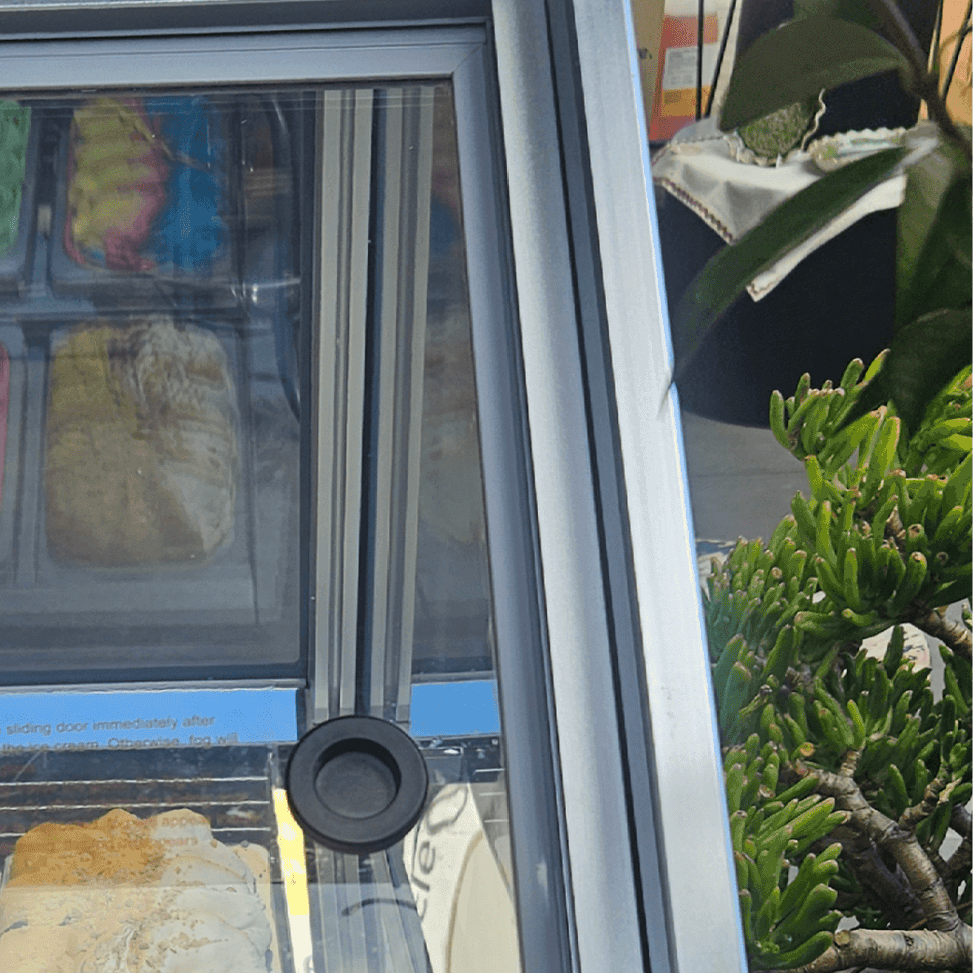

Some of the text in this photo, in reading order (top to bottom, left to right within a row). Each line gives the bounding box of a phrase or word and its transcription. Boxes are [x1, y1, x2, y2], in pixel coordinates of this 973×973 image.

[6, 722, 52, 736] sliding
[55, 722, 88, 733] door
[93, 716, 178, 731] immediately
[182, 714, 215, 727] after
